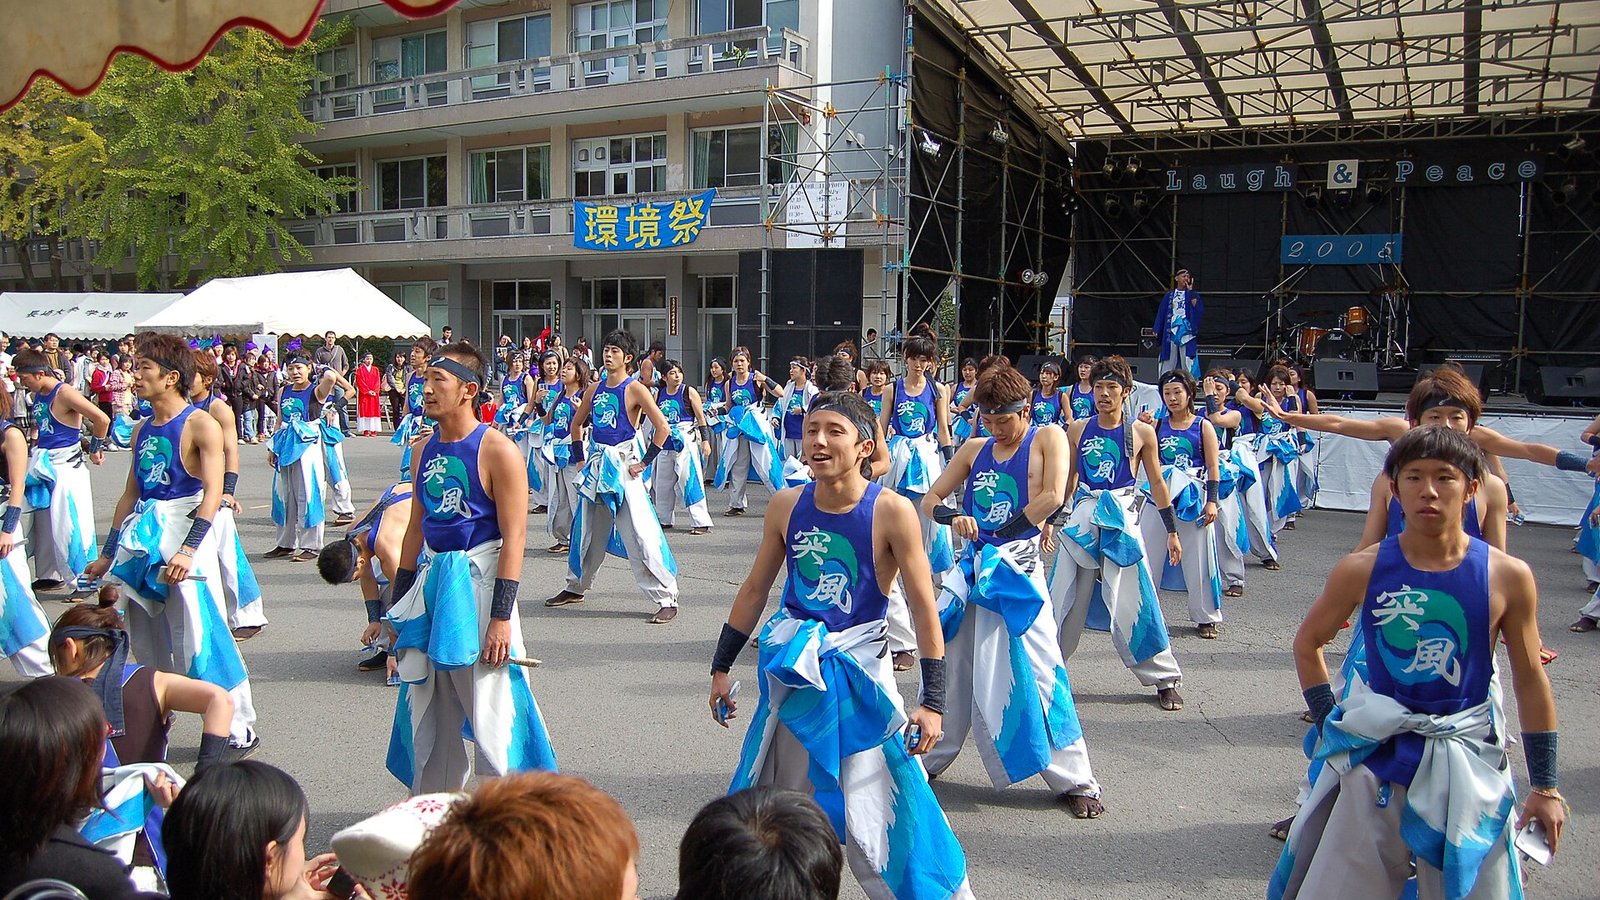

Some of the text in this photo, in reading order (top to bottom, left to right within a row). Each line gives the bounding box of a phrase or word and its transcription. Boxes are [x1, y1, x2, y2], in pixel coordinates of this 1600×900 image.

[1166, 159, 1537, 192] Laugh & Peace
[584, 198, 704, 248] 環境祭
[1287, 240, 1395, 259] 2005
[593, 391, 617, 429] 突風
[896, 400, 926, 434] 突風
[139, 434, 171, 485] 突風
[1081, 435, 1115, 484] 突風
[423, 453, 472, 519] 突風
[972, 469, 1013, 525] 突風
[791, 526, 853, 615] 突風
[1371, 584, 1461, 687] 突風
